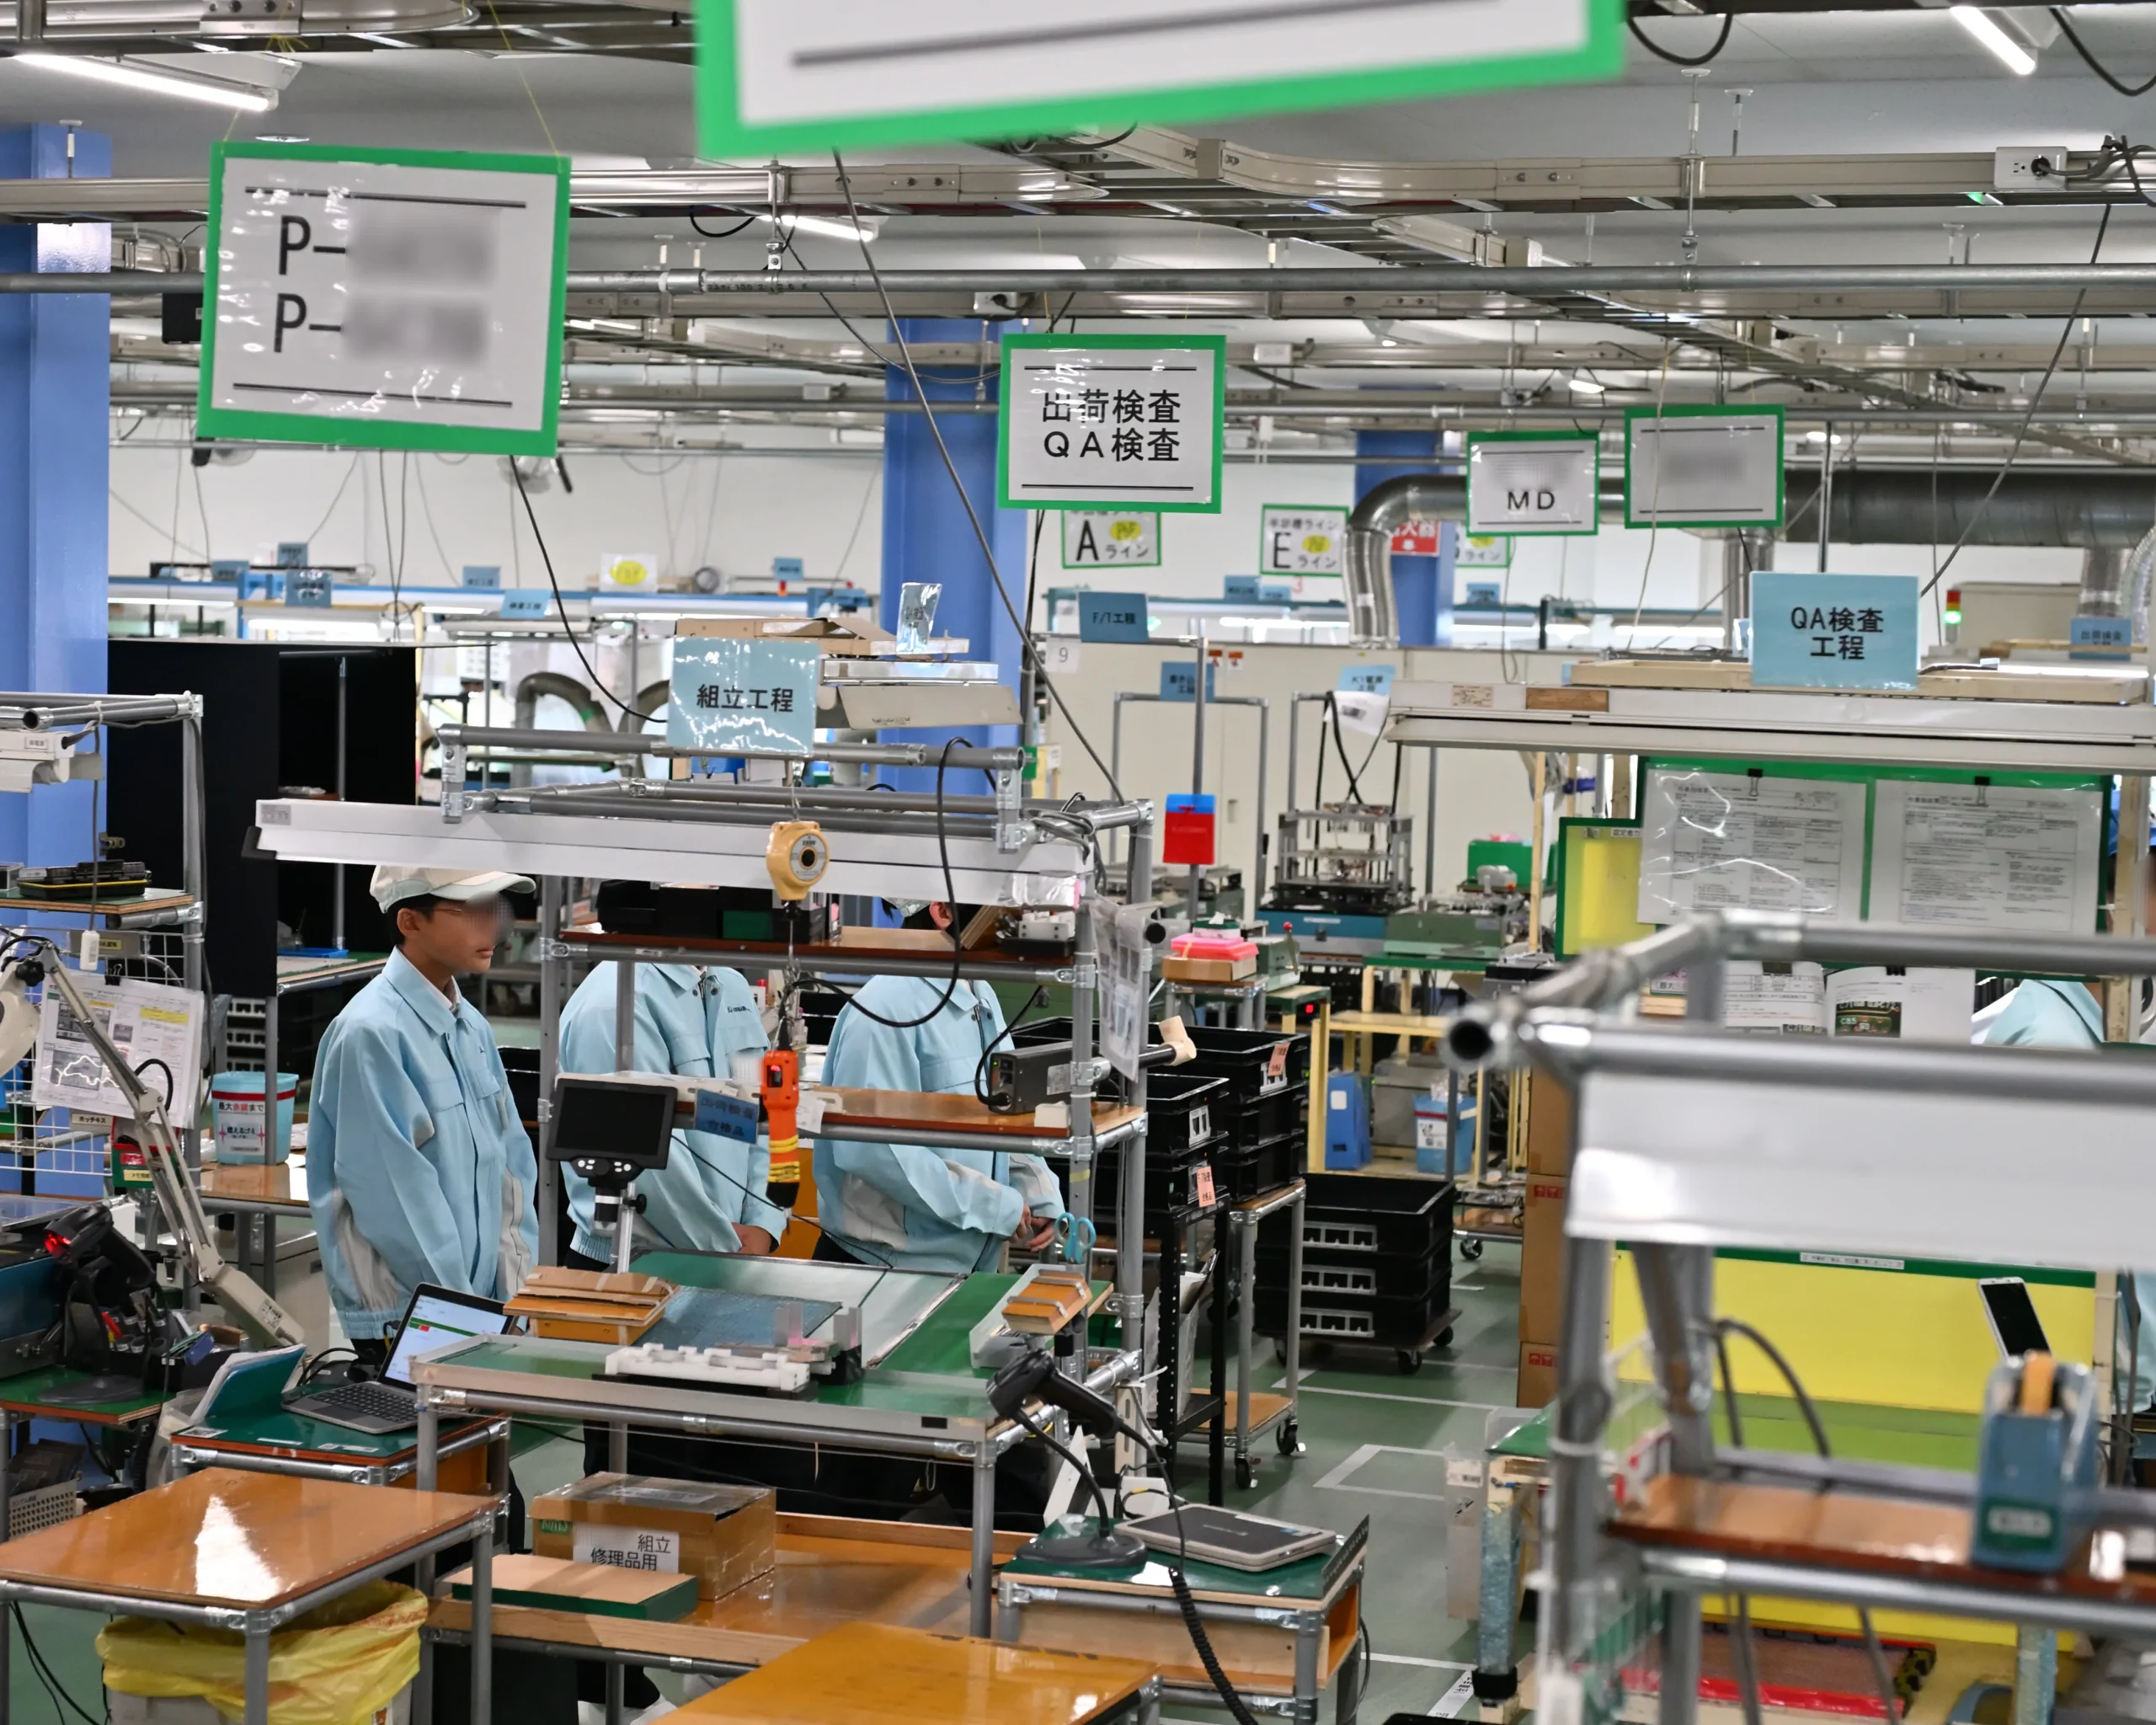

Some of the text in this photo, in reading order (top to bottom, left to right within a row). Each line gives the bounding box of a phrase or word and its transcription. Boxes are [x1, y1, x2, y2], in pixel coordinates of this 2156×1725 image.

[1042, 388, 1182, 424] 出荷検査
[1043, 428, 1181, 462] QA検査
[1507, 490, 1556, 510] MD
[1075, 519, 1100, 562] A
[1104, 543, 1150, 560] ライン
[1273, 531, 1292, 569] E
[1297, 554, 1337, 569] ライン
[1790, 606, 1884, 633] QA検査
[1059, 648, 1069, 663] 9
[1809, 635, 1865, 660] 工程
[696, 683, 795, 713] 組立工程
[637, 1533, 672, 1555] 組立
[590, 1547, 658, 1572] 修理品用
